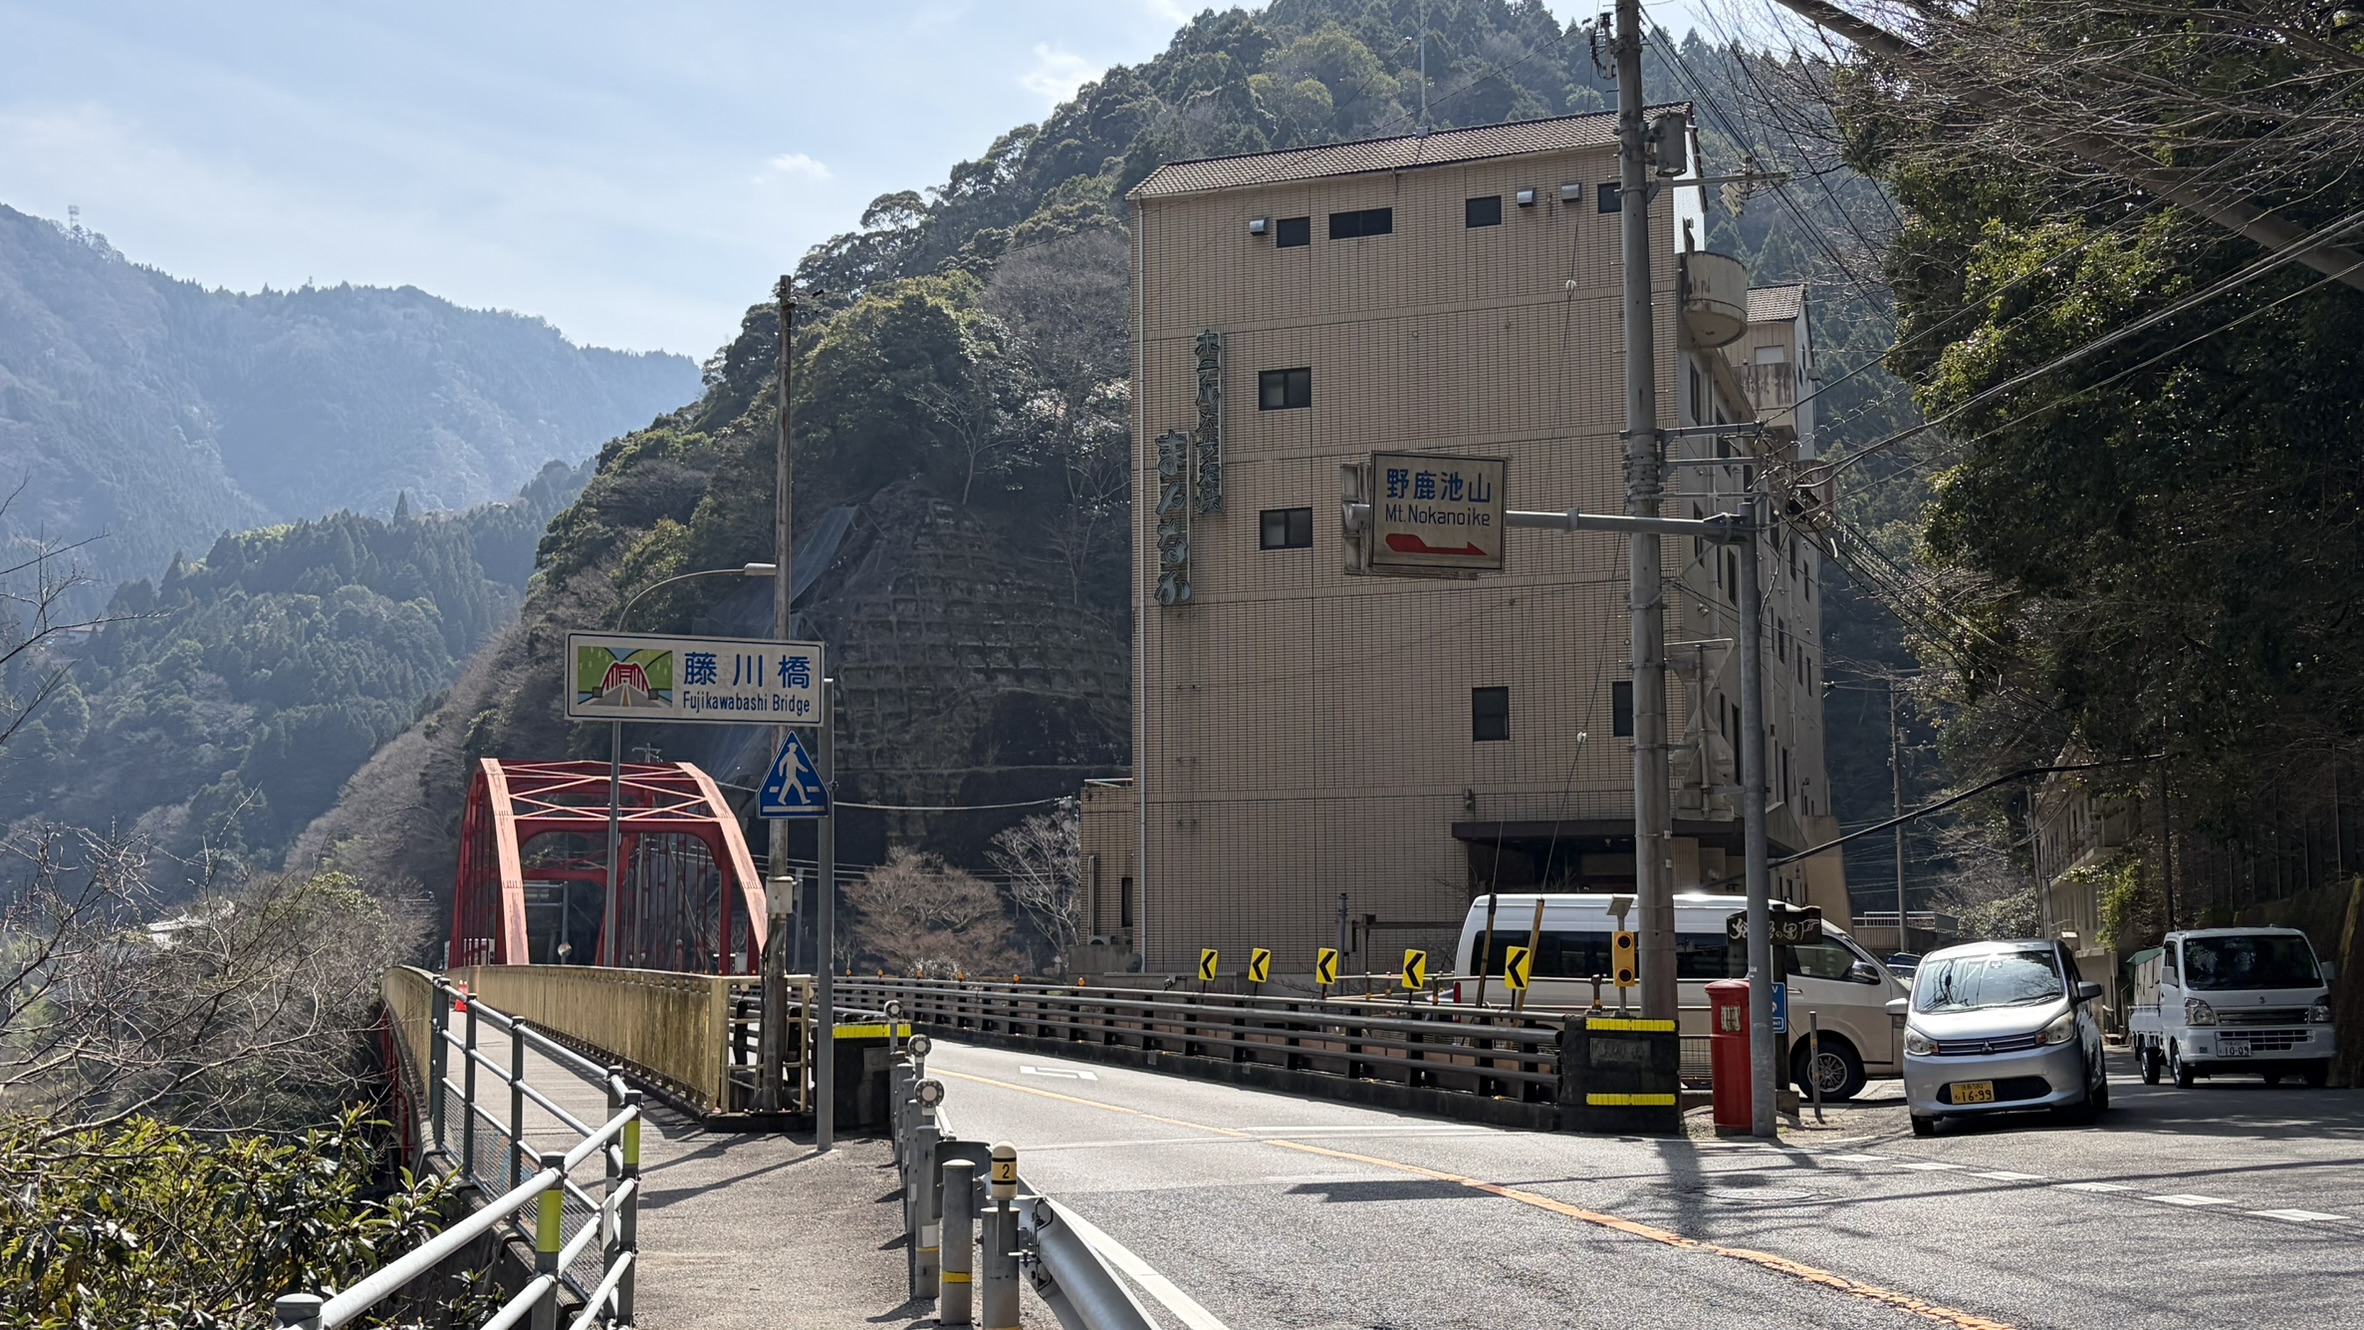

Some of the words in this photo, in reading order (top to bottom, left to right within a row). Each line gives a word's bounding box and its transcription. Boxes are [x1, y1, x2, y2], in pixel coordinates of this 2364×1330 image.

[1386, 468, 1491, 503] 野鹿池山
[1154, 429, 1191, 606] まんなか
[683, 652, 811, 689] 藤川橋
[683, 690, 768, 714] Fujikawabashi
[773, 694, 811, 716] Bridge
[1962, 1089, 1992, 1102] 16-99
[1001, 1163, 1010, 1180] 2
